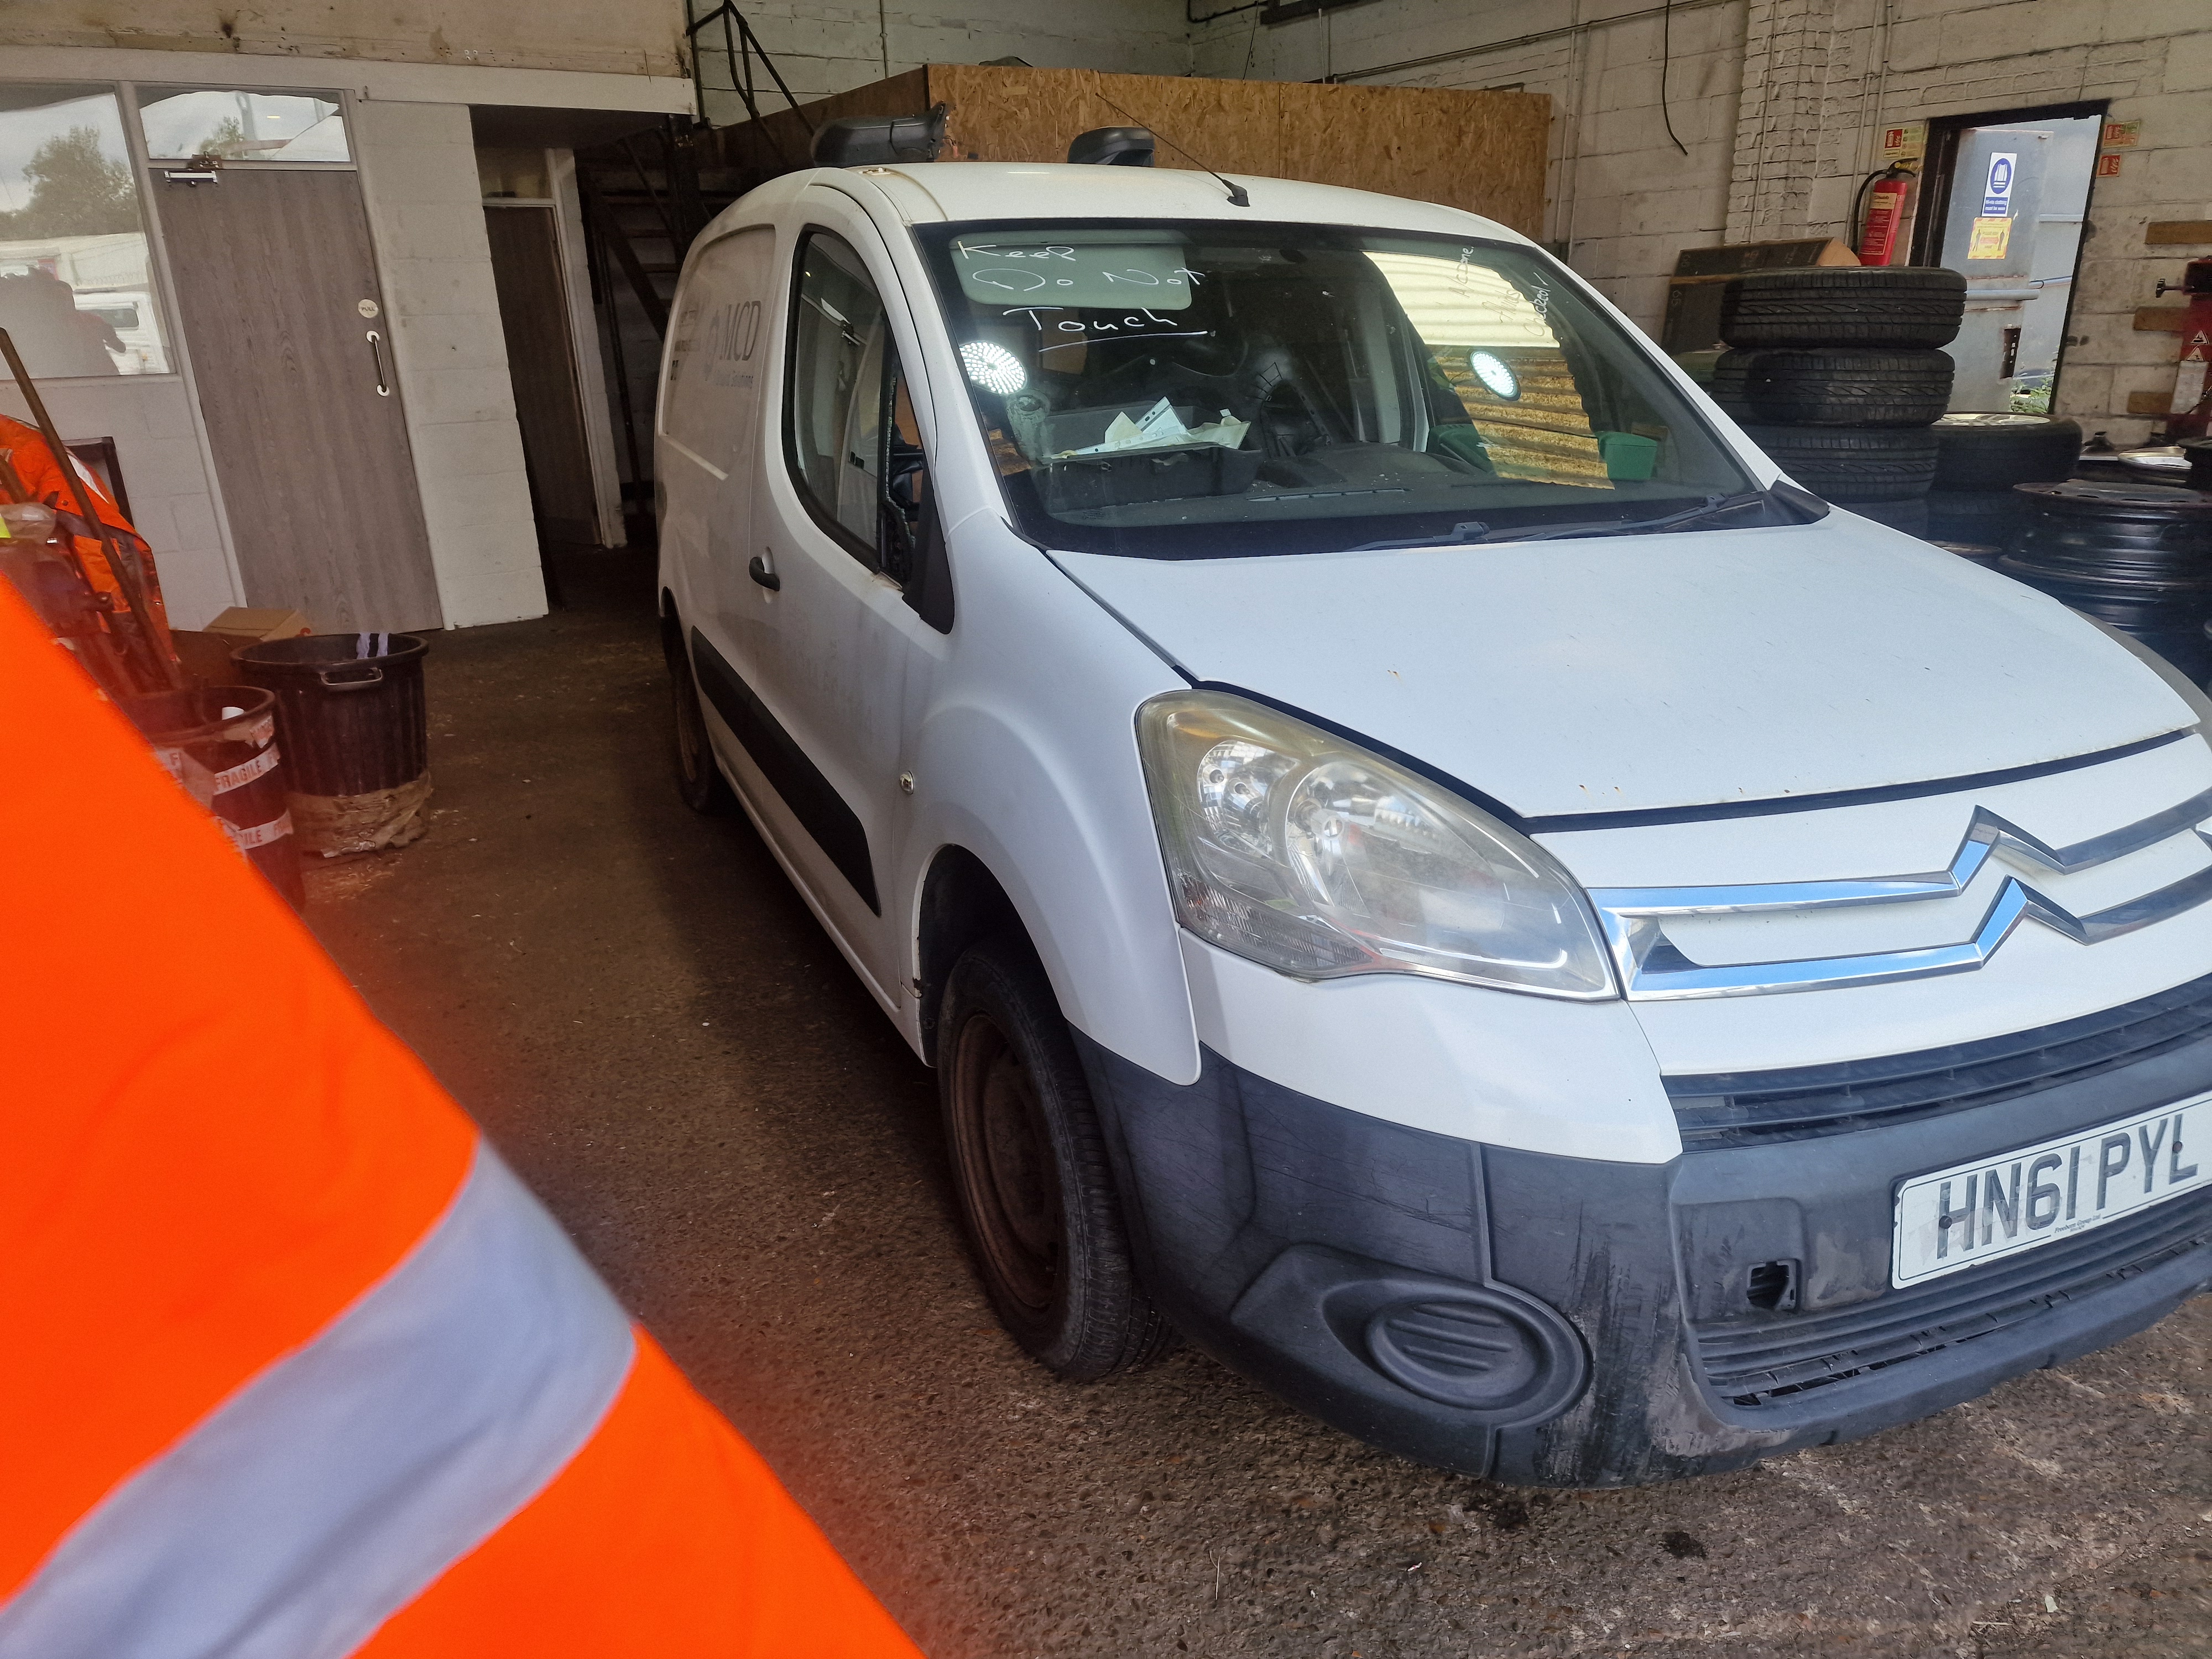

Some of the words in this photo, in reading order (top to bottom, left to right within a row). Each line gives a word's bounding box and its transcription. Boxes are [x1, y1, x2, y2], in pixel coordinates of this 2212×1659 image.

[972, 268, 1074, 291] Do
[1003, 306, 1178, 332] Touch
[215, 759, 263, 791] FRAGILE
[1937, 1145, 2081, 1260] HN61
[2096, 1113, 2199, 1211] PYL
